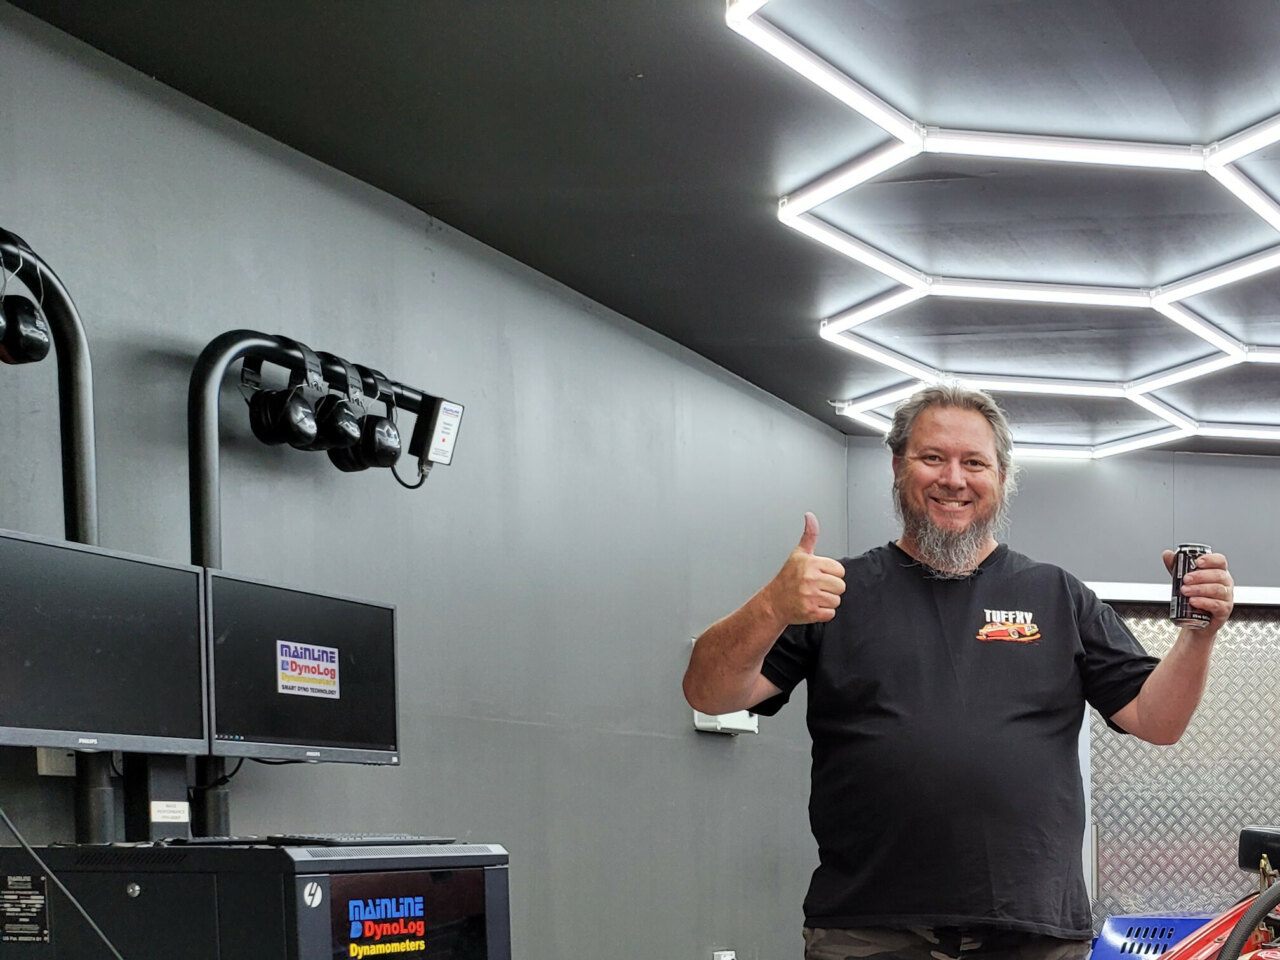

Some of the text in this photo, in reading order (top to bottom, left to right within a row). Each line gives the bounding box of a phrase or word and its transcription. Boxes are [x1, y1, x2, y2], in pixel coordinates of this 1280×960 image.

[290, 660, 336, 680] DynoLog
[349, 896, 424, 920] MAINLINE
[364, 919, 425, 940] DynoLog
[349, 939, 426, 960] Dynamometers
